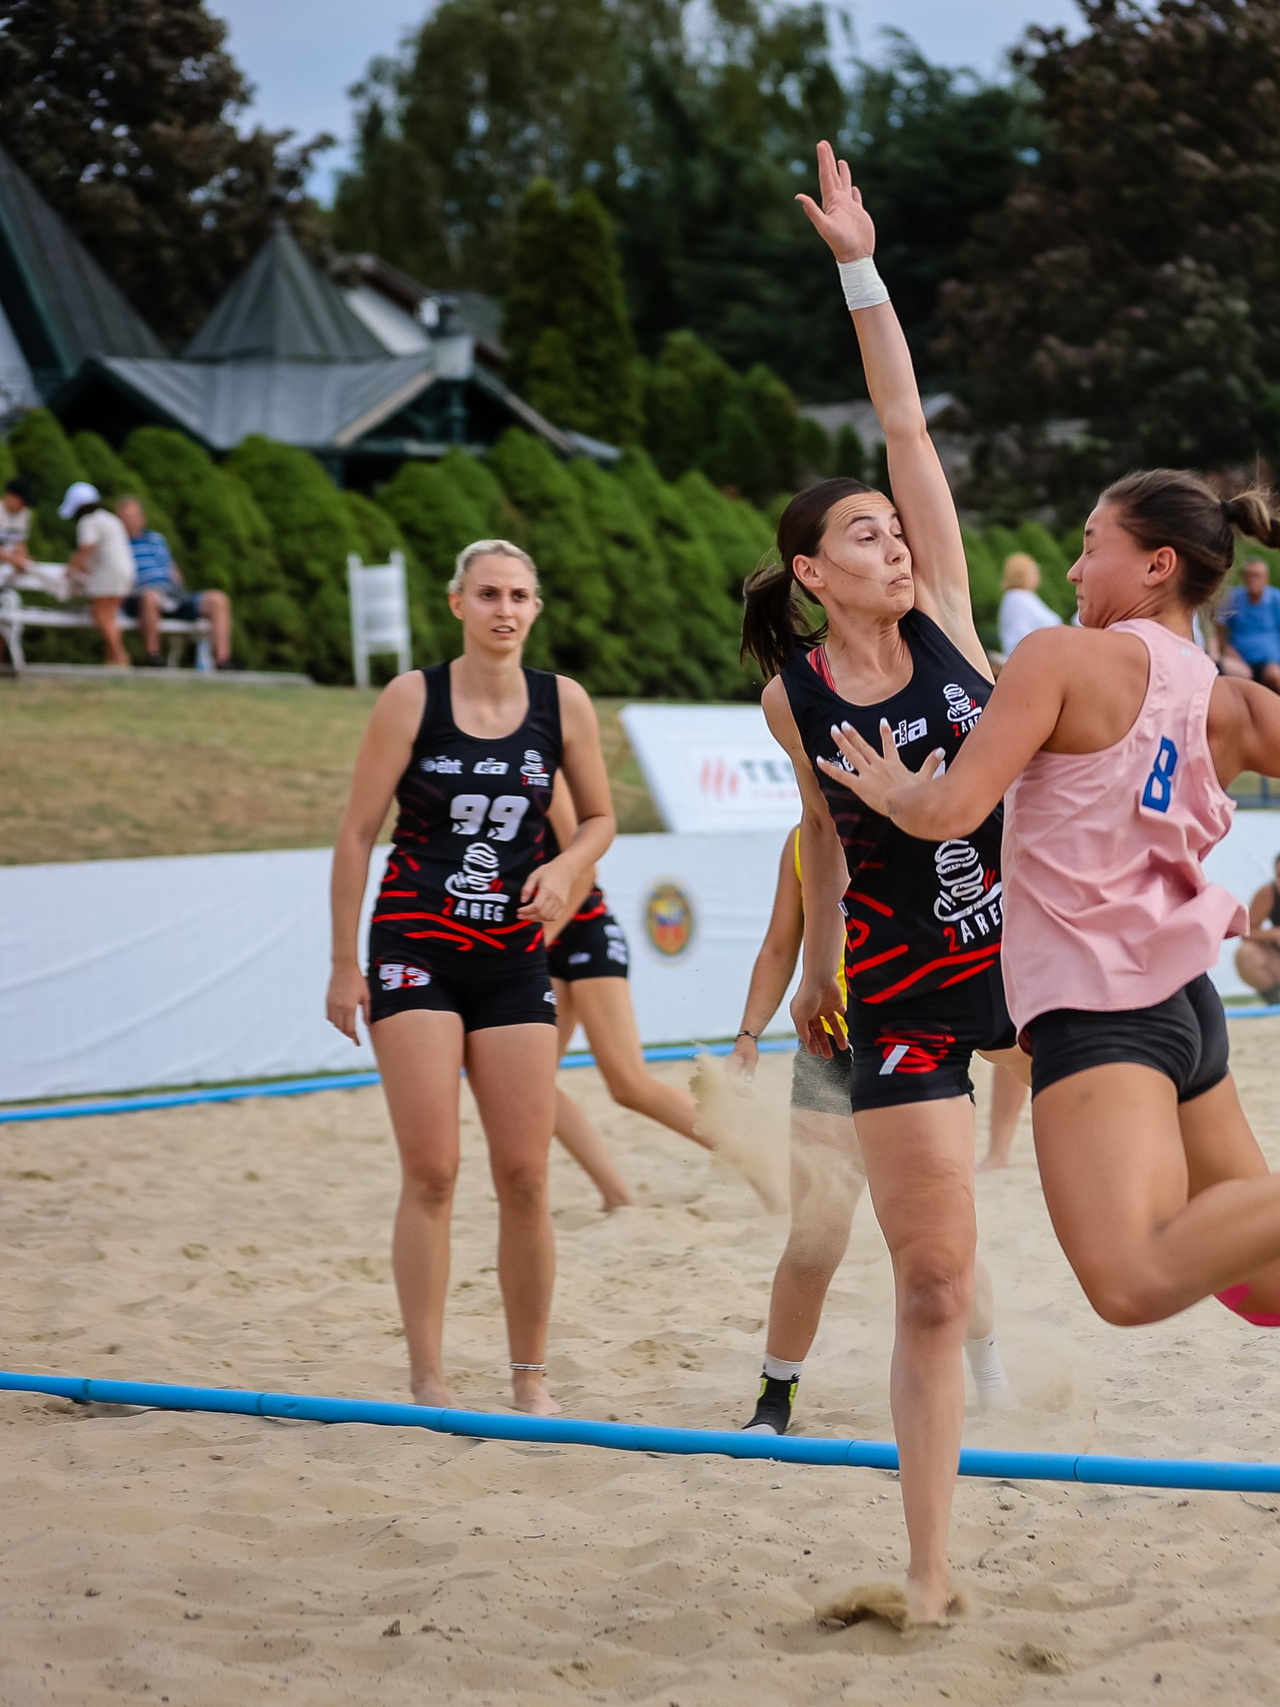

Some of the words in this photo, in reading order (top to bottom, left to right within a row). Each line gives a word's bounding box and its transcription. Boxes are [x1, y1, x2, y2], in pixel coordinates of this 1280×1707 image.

[1142, 735, 1178, 813] 8
[450, 794, 530, 841] 99
[441, 897, 505, 922] 2AREG
[943, 898, 1002, 953] 2ARE
